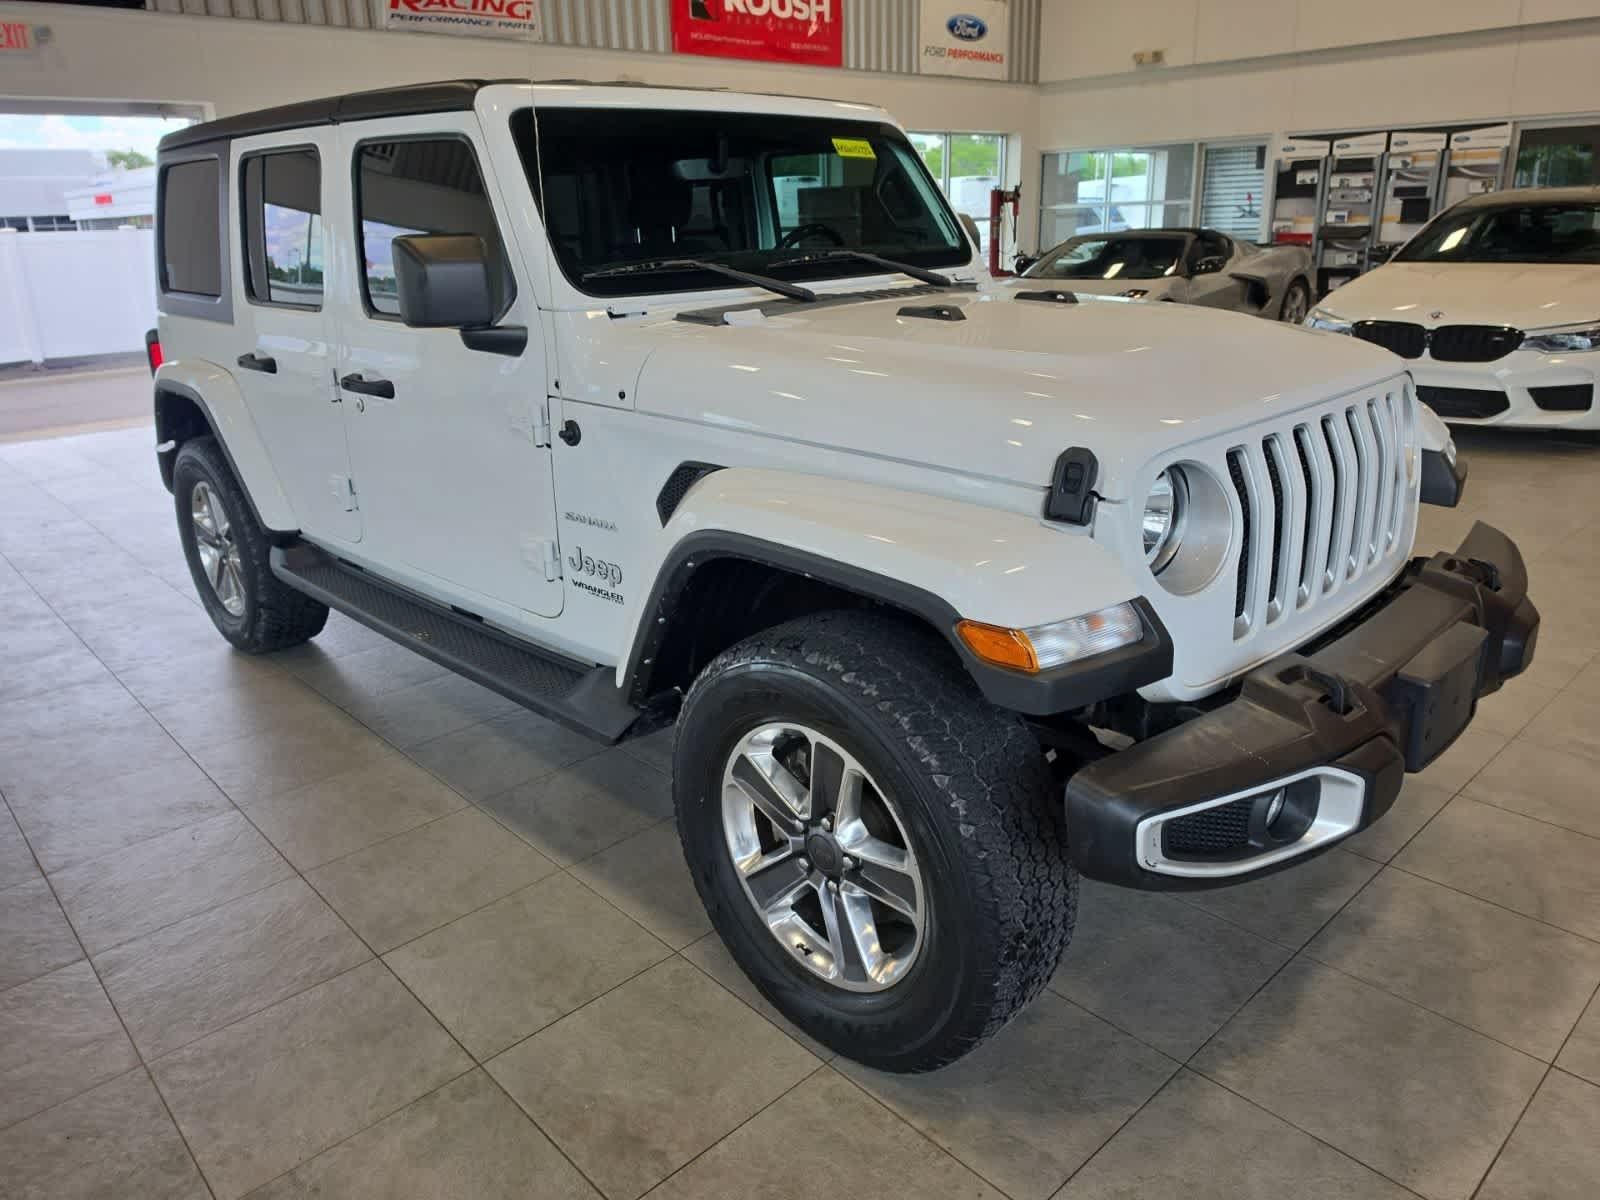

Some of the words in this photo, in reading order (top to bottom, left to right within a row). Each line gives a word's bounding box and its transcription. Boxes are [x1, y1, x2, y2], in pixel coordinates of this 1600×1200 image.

[389, 13, 495, 26] PERFORMANCE
[497, 20, 536, 30] PARTS
[949, 16, 983, 37] Ford
[923, 45, 946, 57] FORD
[568, 545, 623, 588] Jeep
[572, 578, 623, 602] WRANGLER
